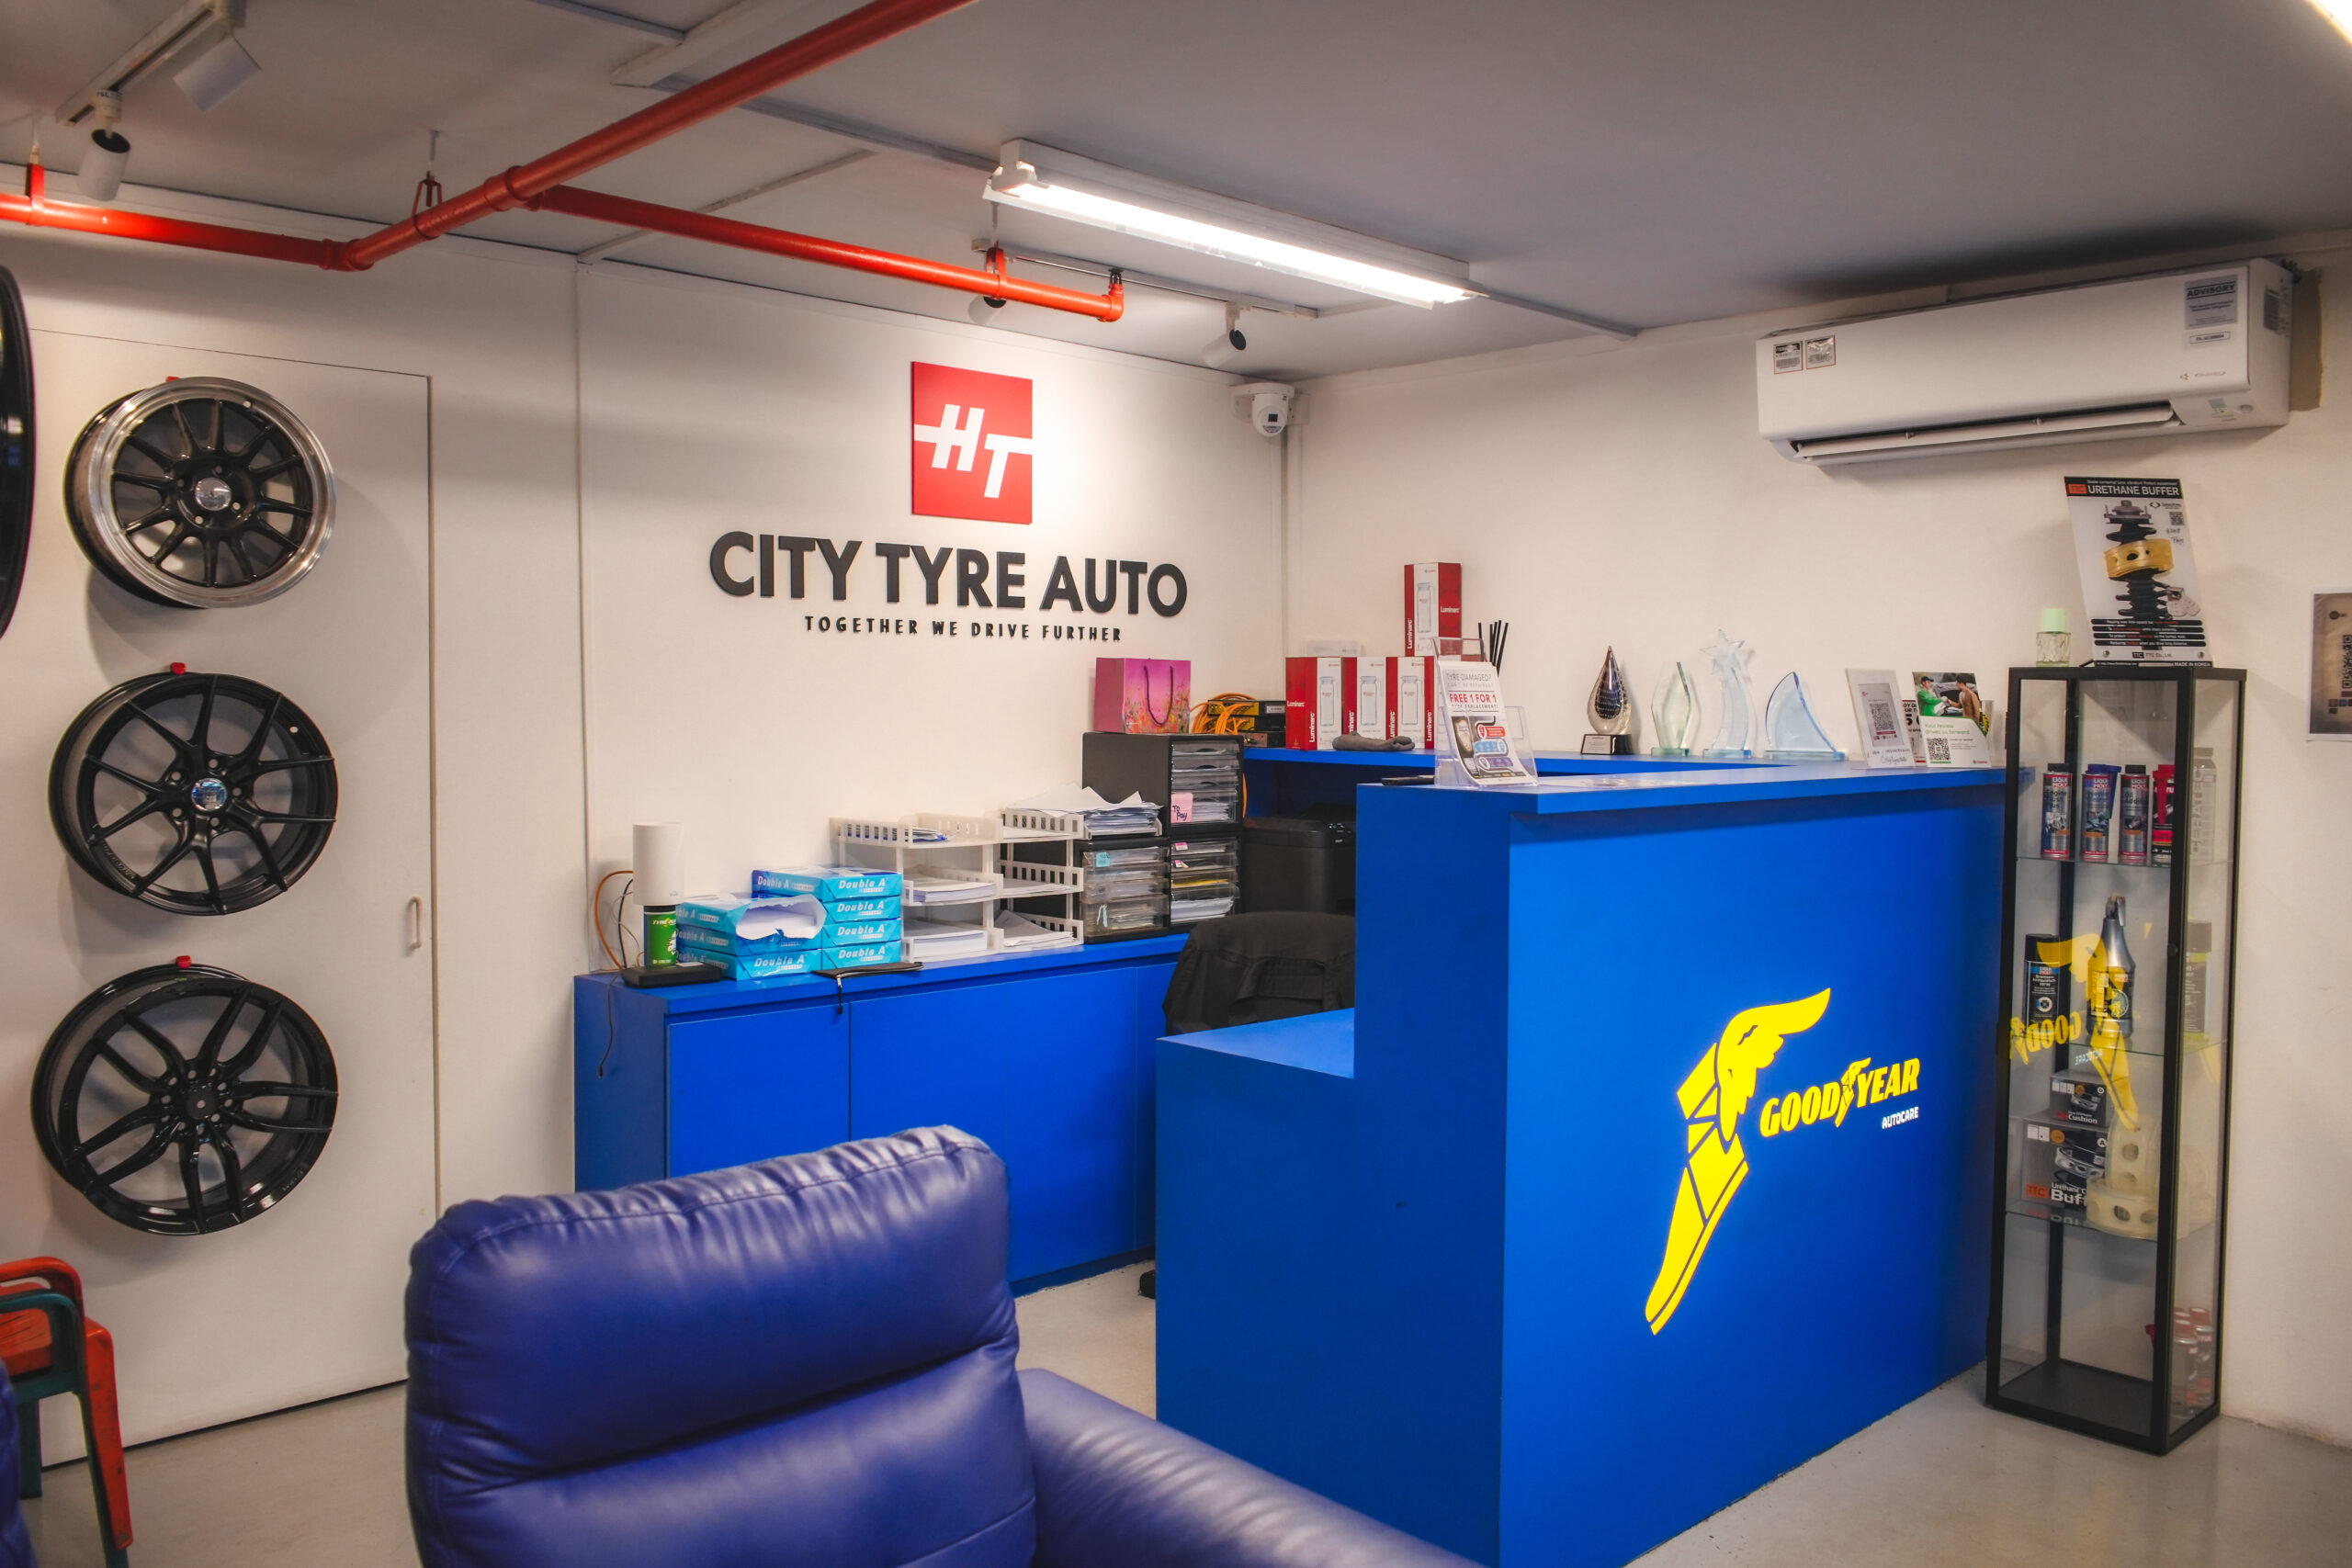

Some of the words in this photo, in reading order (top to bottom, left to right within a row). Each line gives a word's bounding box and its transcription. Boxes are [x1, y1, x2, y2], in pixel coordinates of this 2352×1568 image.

[2187, 284, 2235, 297] ADVISORY
[914, 403, 1033, 498] HT
[2087, 484, 2141, 495] URETHANE
[2142, 485, 2180, 496] BUFFER
[709, 530, 862, 602] CITY
[876, 542, 1026, 609] TYRE
[1040, 555, 1188, 617] AUTO
[805, 615, 918, 636] TOGETHER
[932, 620, 958, 637] WE
[971, 622, 1030, 639] DRIVE
[1042, 625, 1122, 642] FURTHER
[1449, 694, 1469, 704] FREE
[1470, 694, 1475, 704] 1
[1475, 694, 1491, 704] FOR
[1492, 694, 1498, 704] 1
[757, 875, 783, 889] Double
[784, 879, 790, 889] A
[839, 878, 876, 889] Double
[878, 878, 886, 886] A
[837, 901, 874, 912] Double
[877, 900, 885, 909] A
[837, 925, 875, 936] Double
[877, 924, 885, 933] A
[838, 947, 876, 959] Double
[877, 946, 886, 955] A
[754, 956, 793, 967] Double
[797, 954, 805, 964] A
[1759, 1057, 1920, 1138] GOODYEAR
[1882, 1106, 1919, 1129] AUTOCARE
[2068, 1113, 2098, 1123] Cushion
[2052, 1182, 2079, 1194] Urethane
